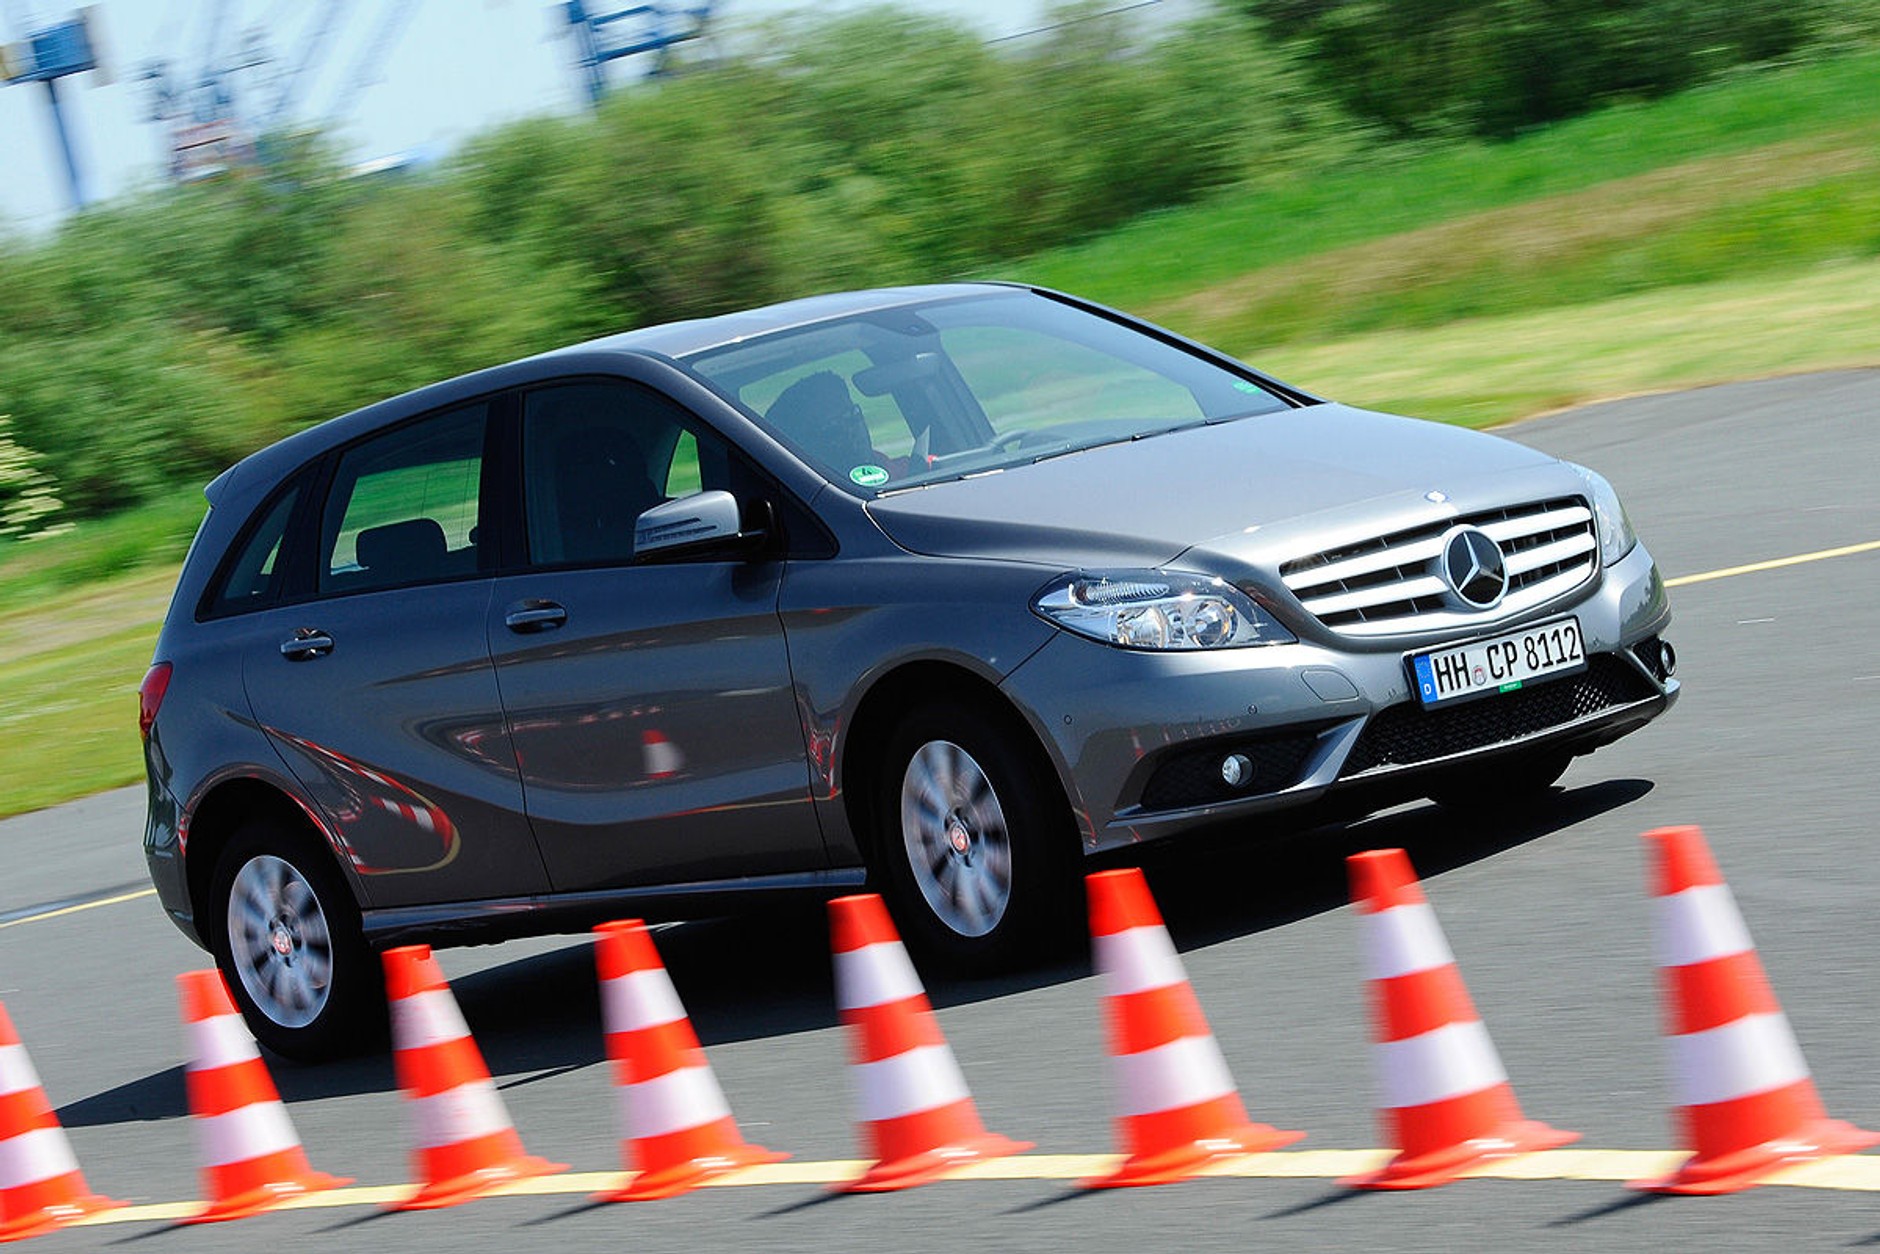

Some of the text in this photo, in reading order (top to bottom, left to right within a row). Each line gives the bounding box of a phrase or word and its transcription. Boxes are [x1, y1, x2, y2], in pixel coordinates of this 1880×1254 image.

[1433, 626, 1581, 693] HH CP 8112
[1423, 683, 1432, 695] D
